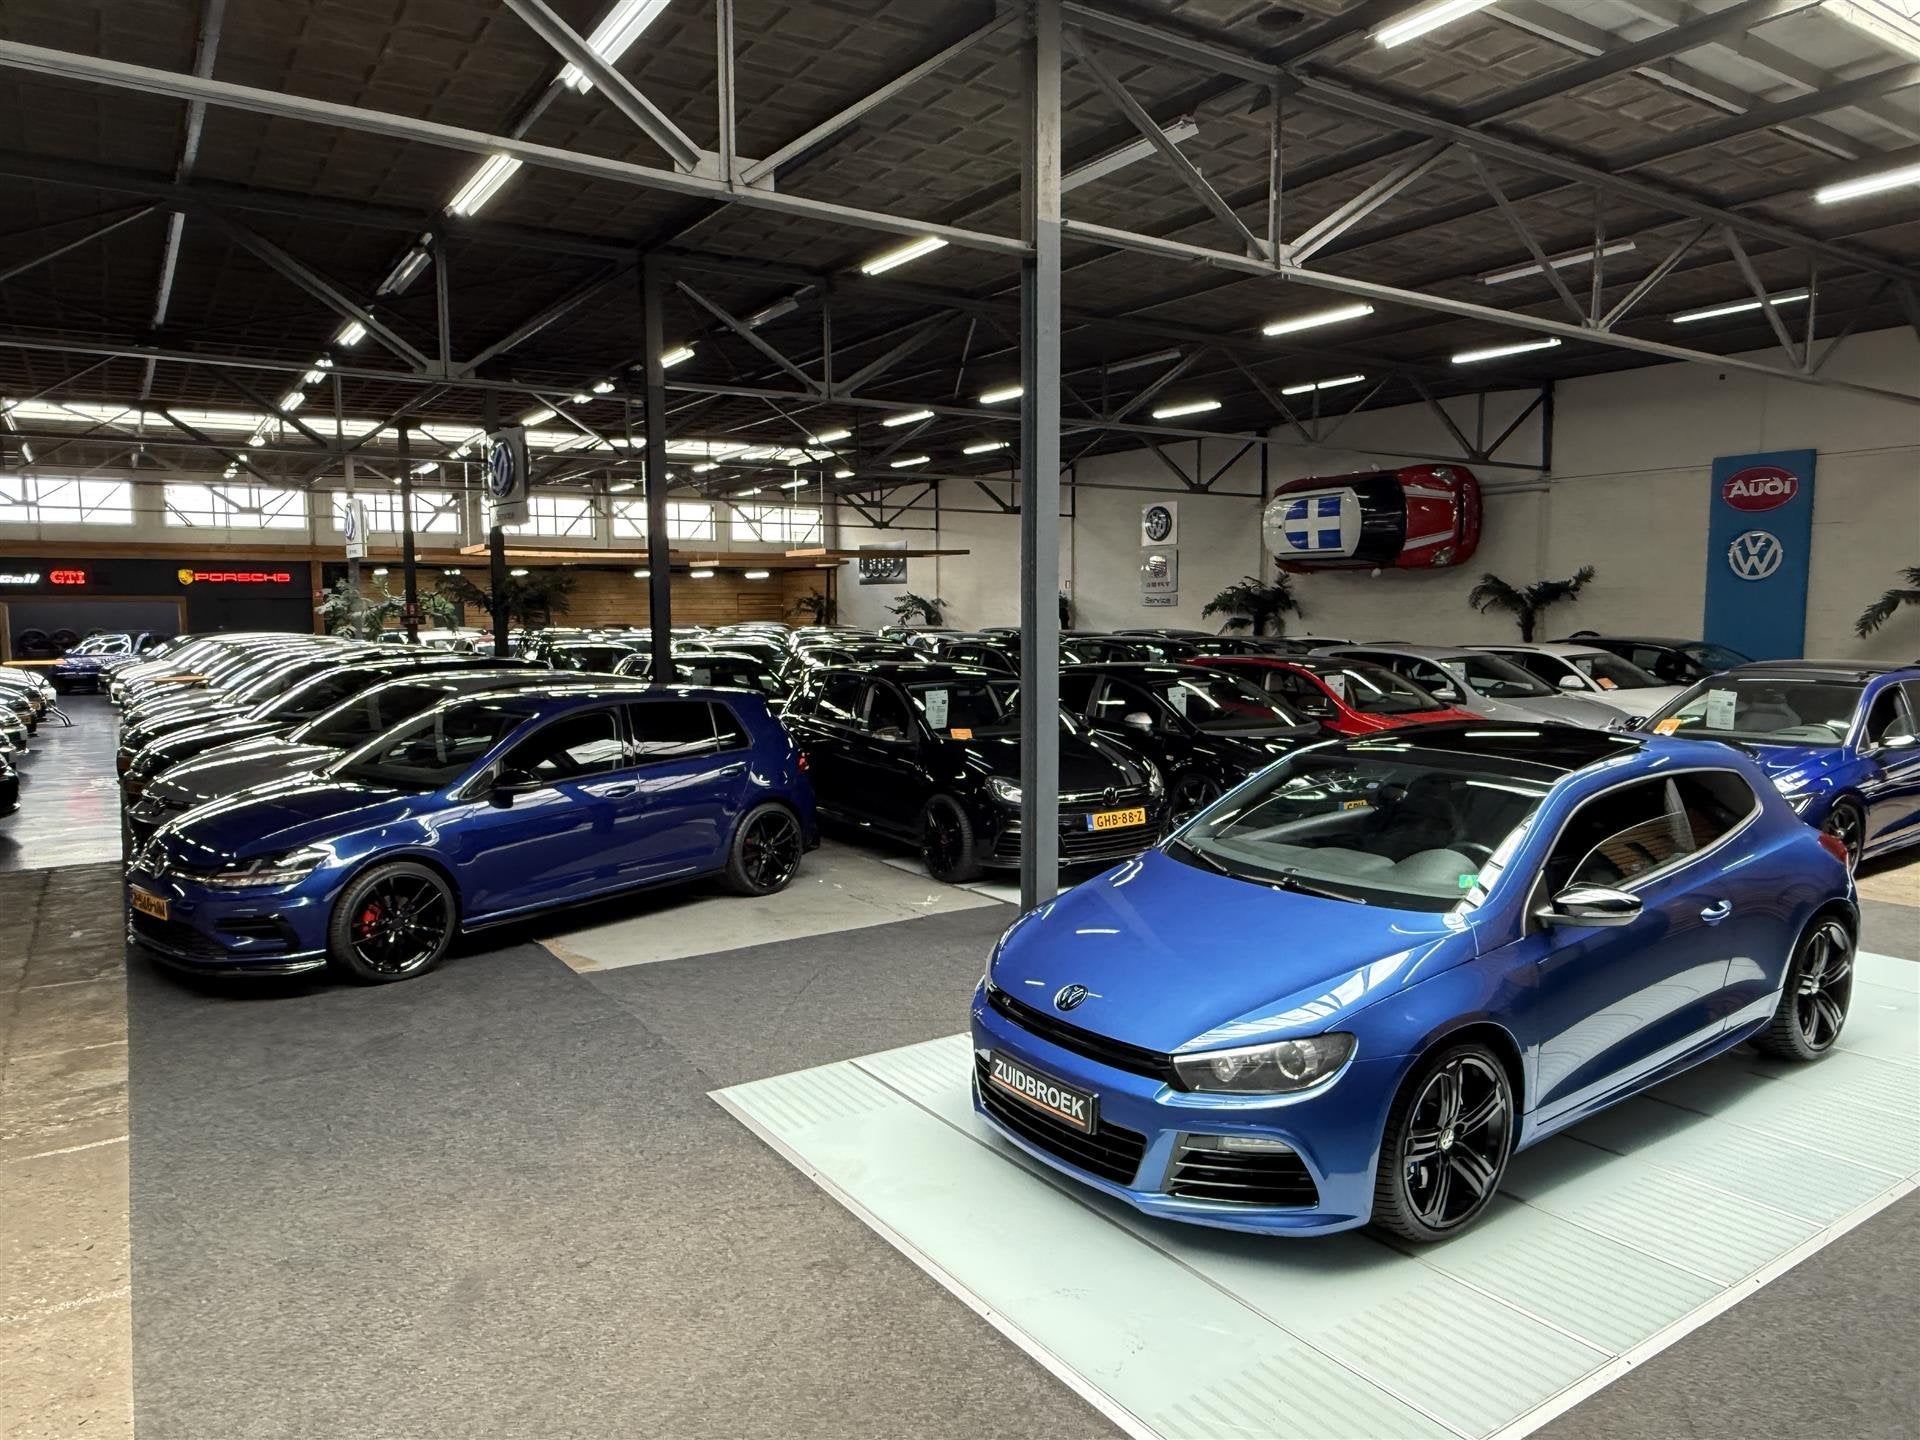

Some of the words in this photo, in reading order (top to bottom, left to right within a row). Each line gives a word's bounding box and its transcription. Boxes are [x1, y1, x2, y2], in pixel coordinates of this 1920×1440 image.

[1728, 477, 1792, 498] Audi
[50, 570, 86, 585] GTI
[194, 573, 291, 582] PORSCHE
[1097, 810, 1143, 828] GHB-88-Z
[994, 1058, 1085, 1120] ZUIDBROEK
